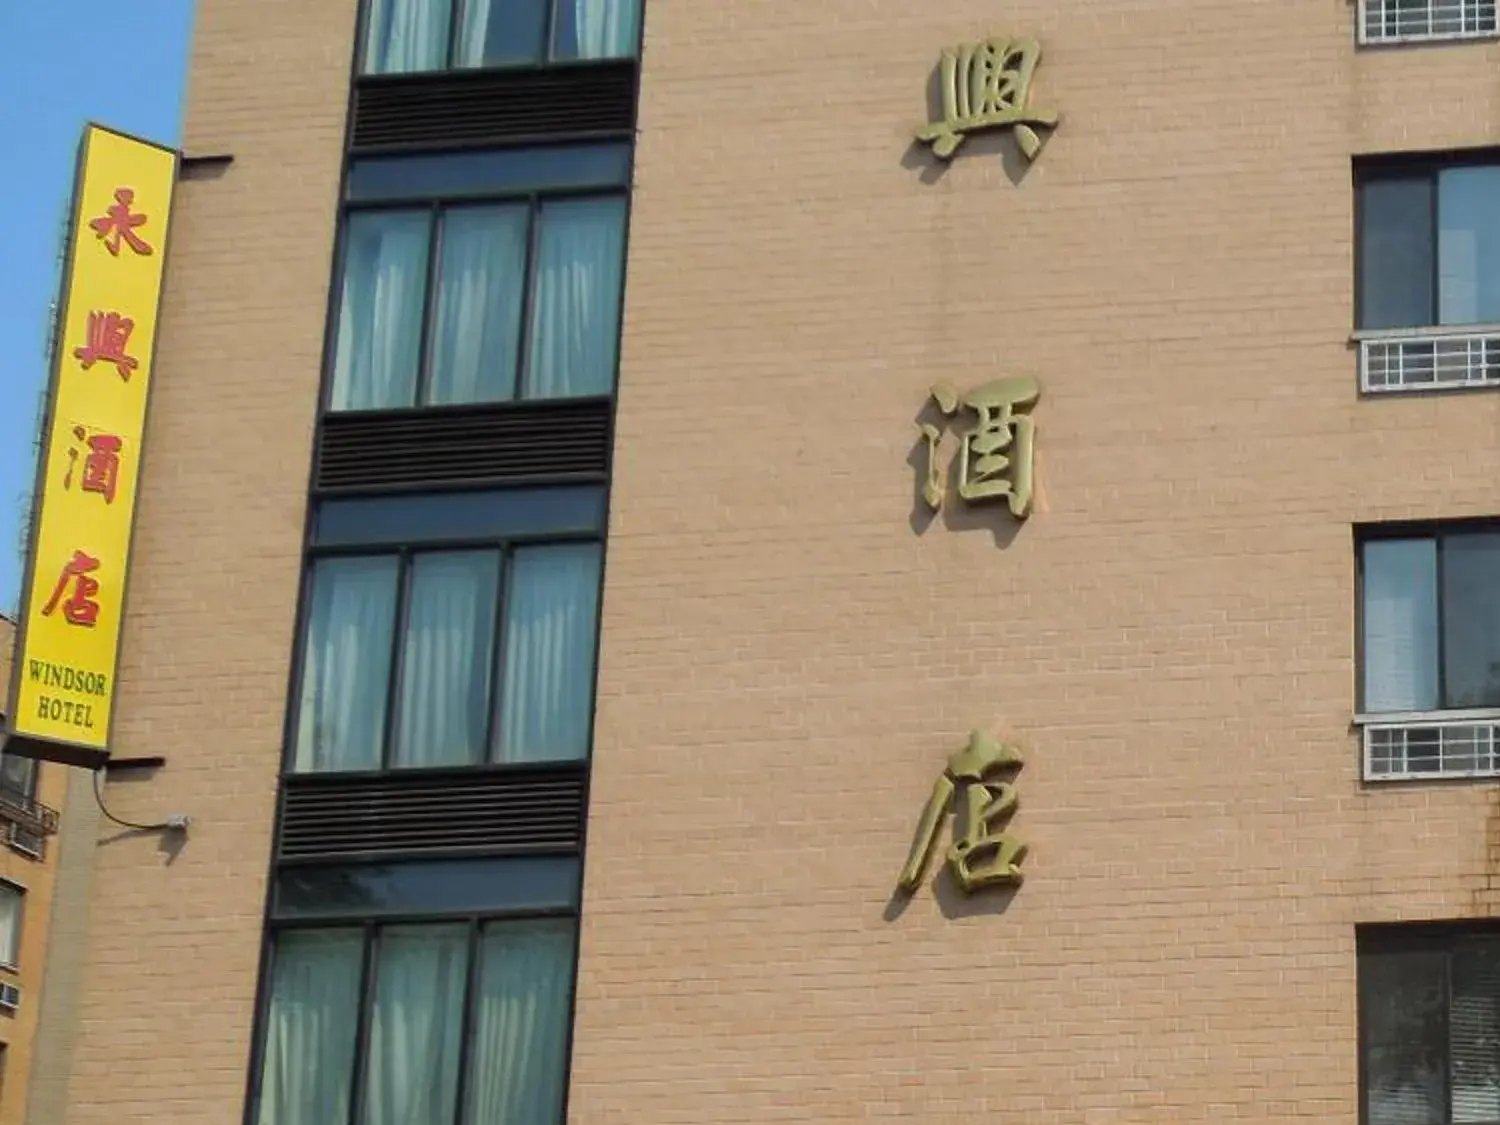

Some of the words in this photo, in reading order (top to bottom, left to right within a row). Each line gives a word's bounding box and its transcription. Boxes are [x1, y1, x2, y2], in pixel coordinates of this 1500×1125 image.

[43, 188, 153, 629] 永興酒店
[30, 659, 106, 696] WINDSOR
[38, 696, 93, 728] HOTEL
